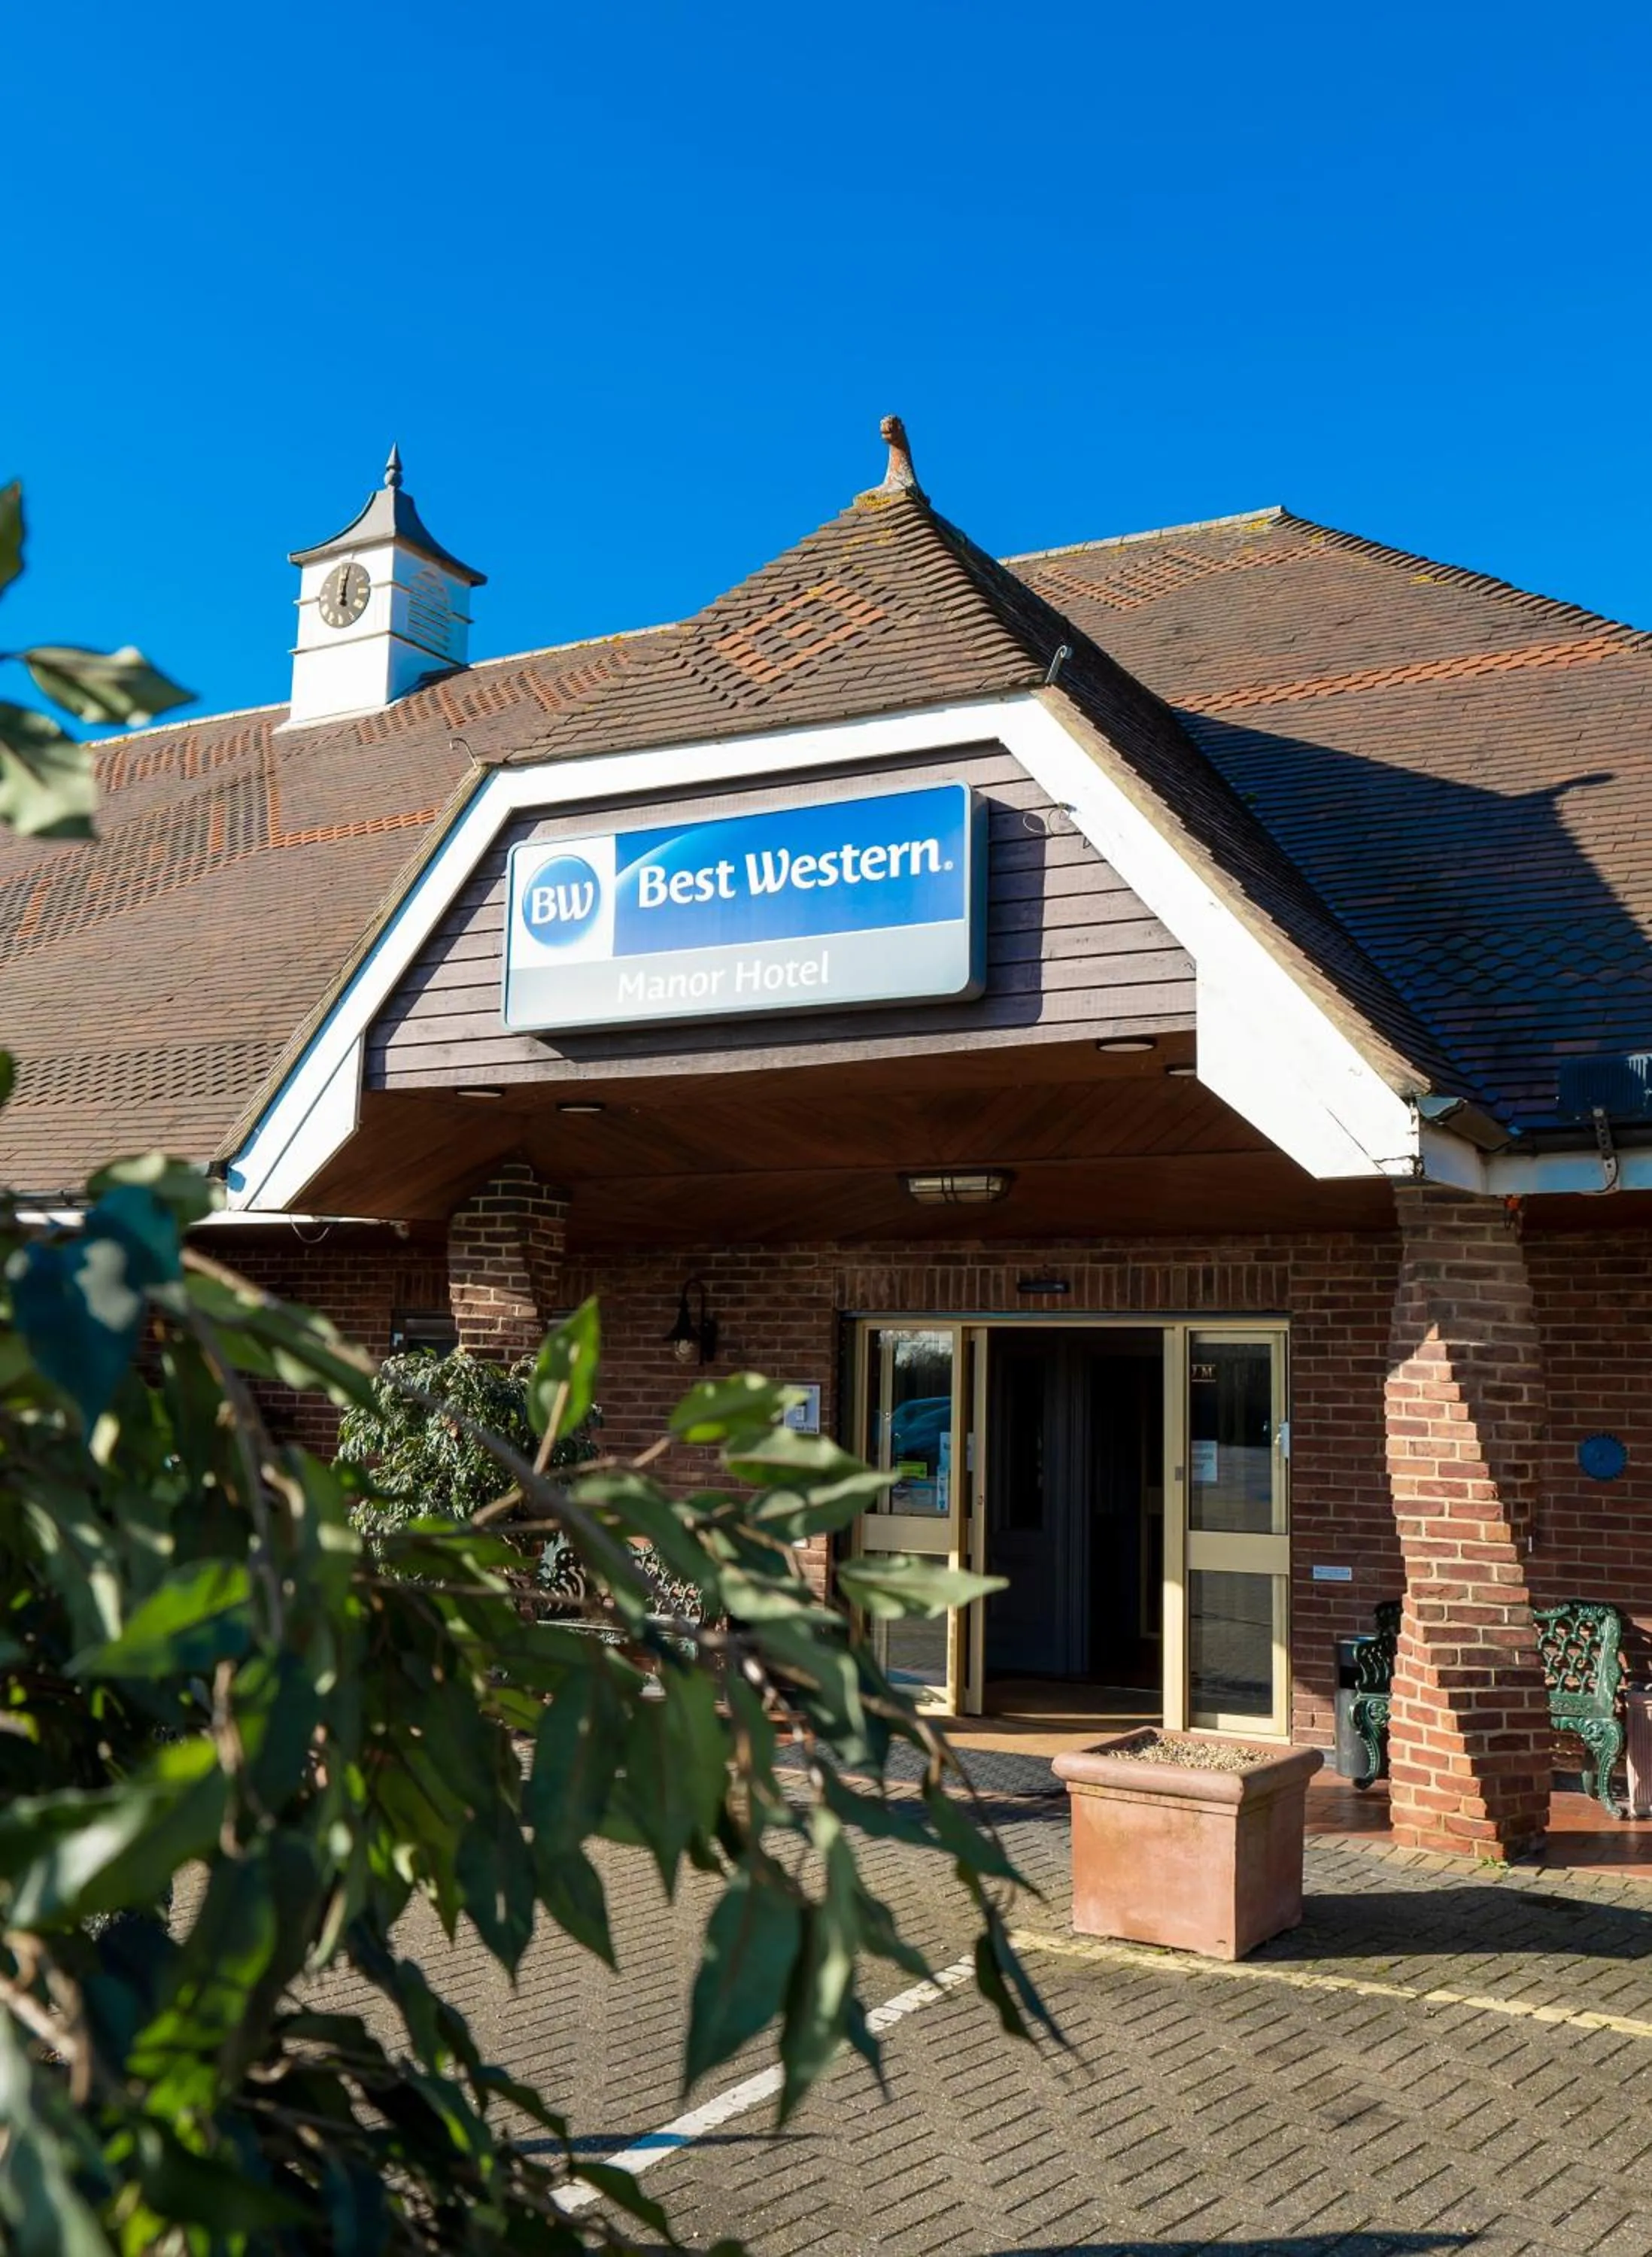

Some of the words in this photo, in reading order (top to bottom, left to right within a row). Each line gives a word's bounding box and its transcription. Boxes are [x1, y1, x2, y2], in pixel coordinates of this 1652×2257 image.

[530, 880, 594, 925] BW
[638, 865, 735, 908] Best
[617, 968, 724, 1003] Manor
[736, 950, 830, 993] Hotel
